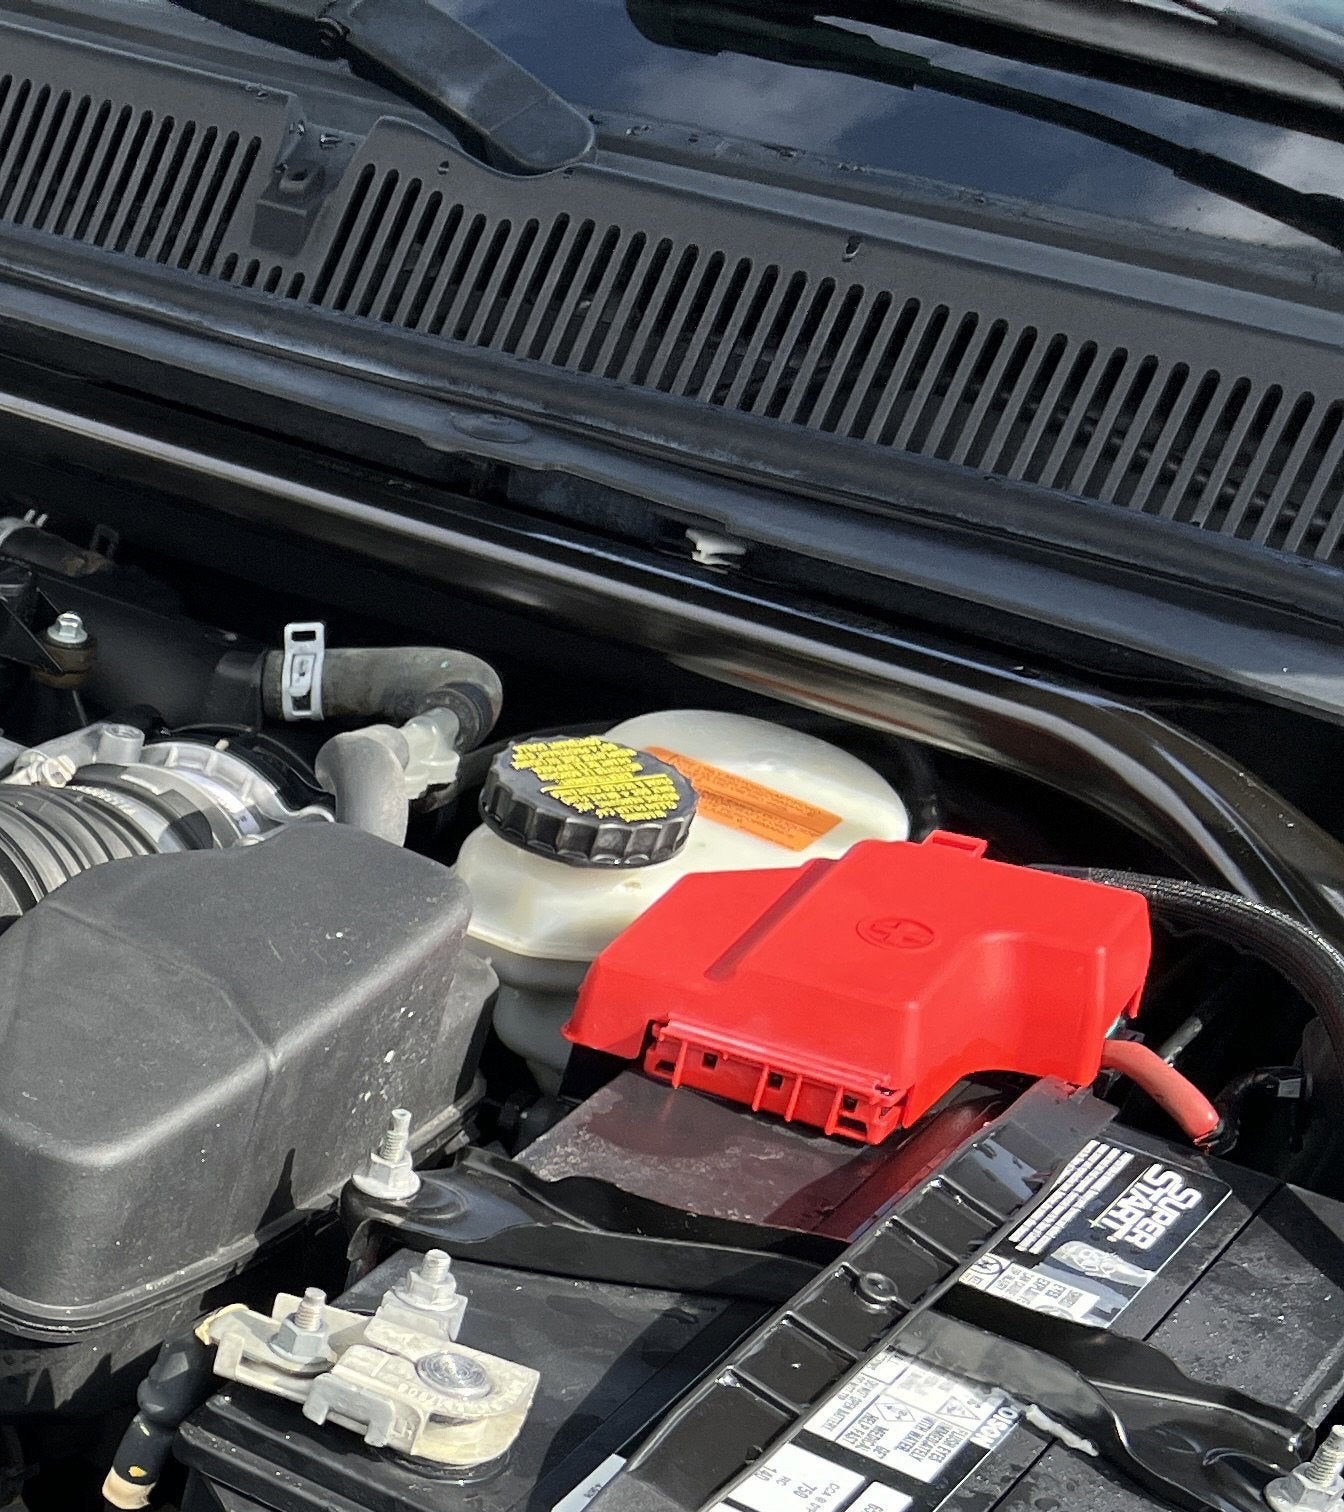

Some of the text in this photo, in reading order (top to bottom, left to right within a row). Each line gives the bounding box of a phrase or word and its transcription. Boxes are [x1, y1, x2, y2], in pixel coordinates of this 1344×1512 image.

[1091, 1162, 1187, 1242] START
[1121, 1181, 1207, 1252] SUPER
[854, 1411, 880, 1431] HELP
[853, 1423, 889, 1453] MEDICAL
[927, 1445, 952, 1464] EYES
[752, 1463, 779, 1482] 140
[774, 1474, 790, 1486] RC
[790, 1480, 817, 1499] 750
